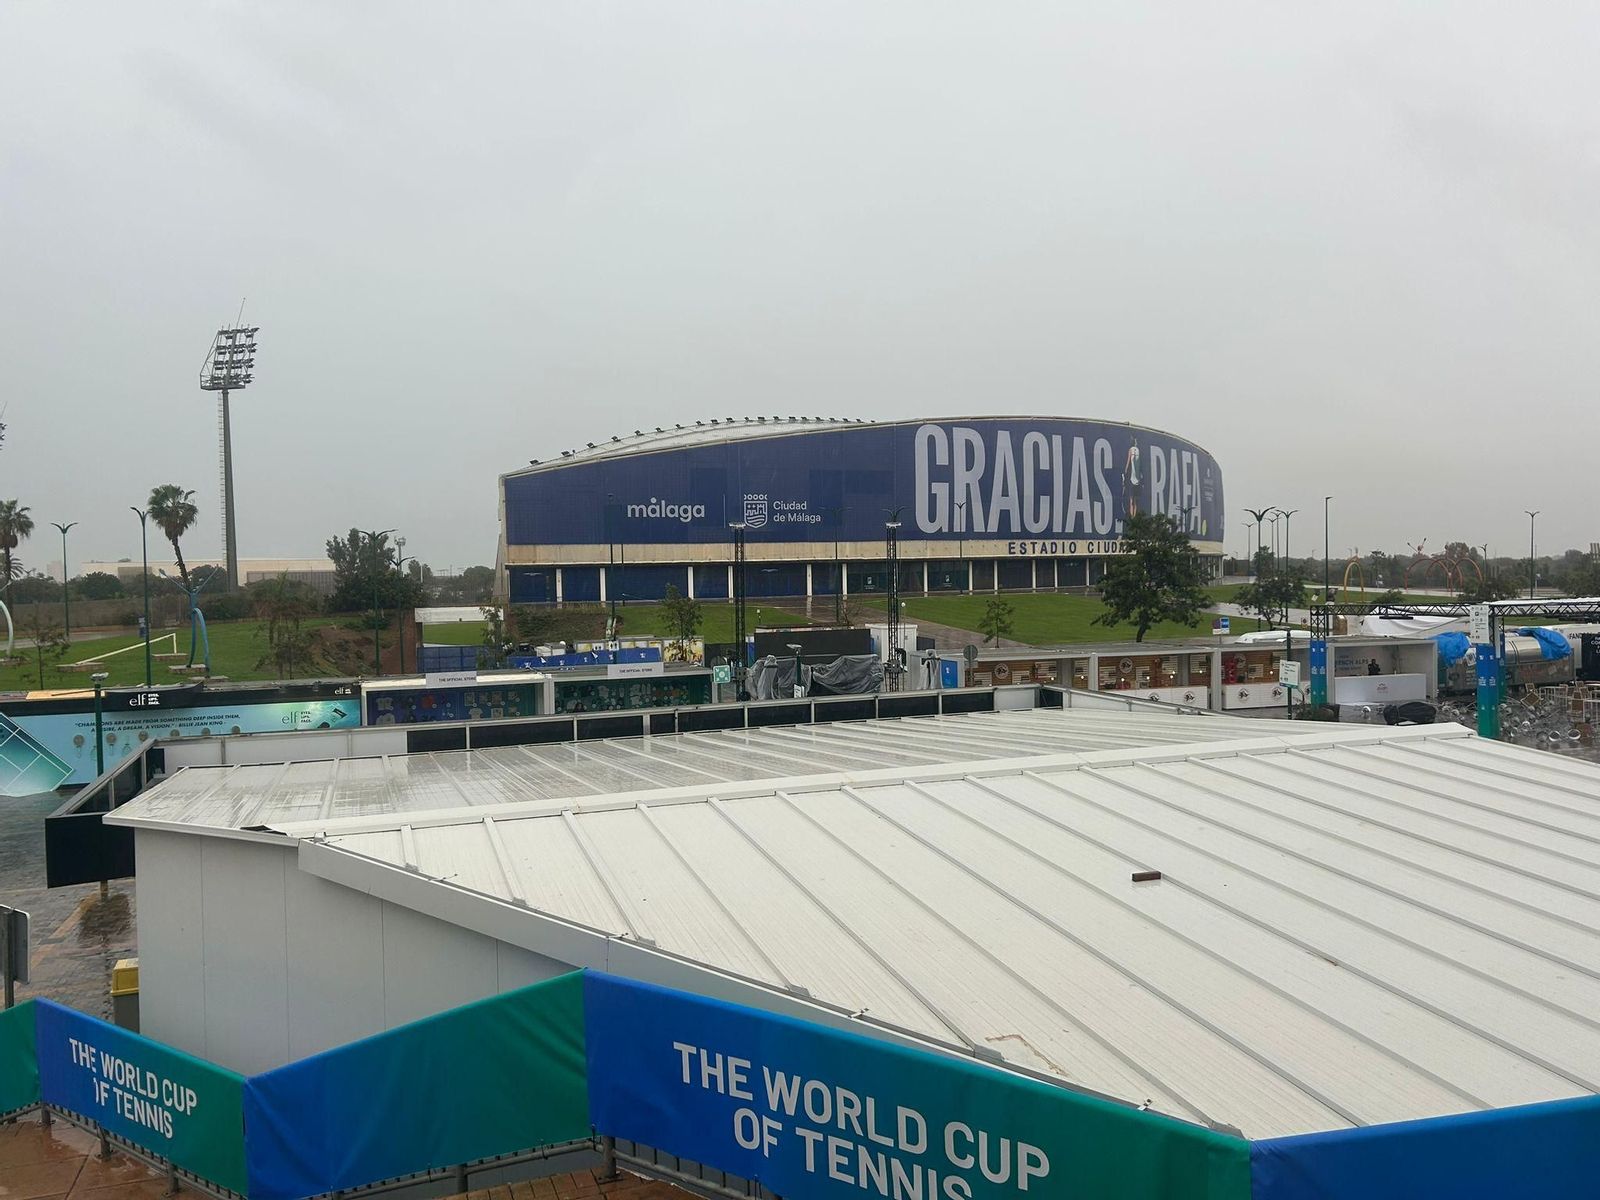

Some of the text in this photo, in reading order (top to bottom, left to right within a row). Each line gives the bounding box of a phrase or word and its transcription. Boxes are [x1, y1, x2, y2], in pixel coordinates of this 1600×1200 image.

[773, 500, 807, 510] Ciudad
[773, 512, 821, 523] de Málaga
[1008, 541, 1126, 554] ESTADIO CIUDA
[129, 694, 147, 706] elf
[282, 711, 299, 724] elf
[69, 1037, 197, 1115] THE WORLD CUP
[113, 1087, 173, 1139] TENNIS
[673, 1041, 1050, 1191] THE WORLD CUP
[734, 1107, 782, 1158] OF
